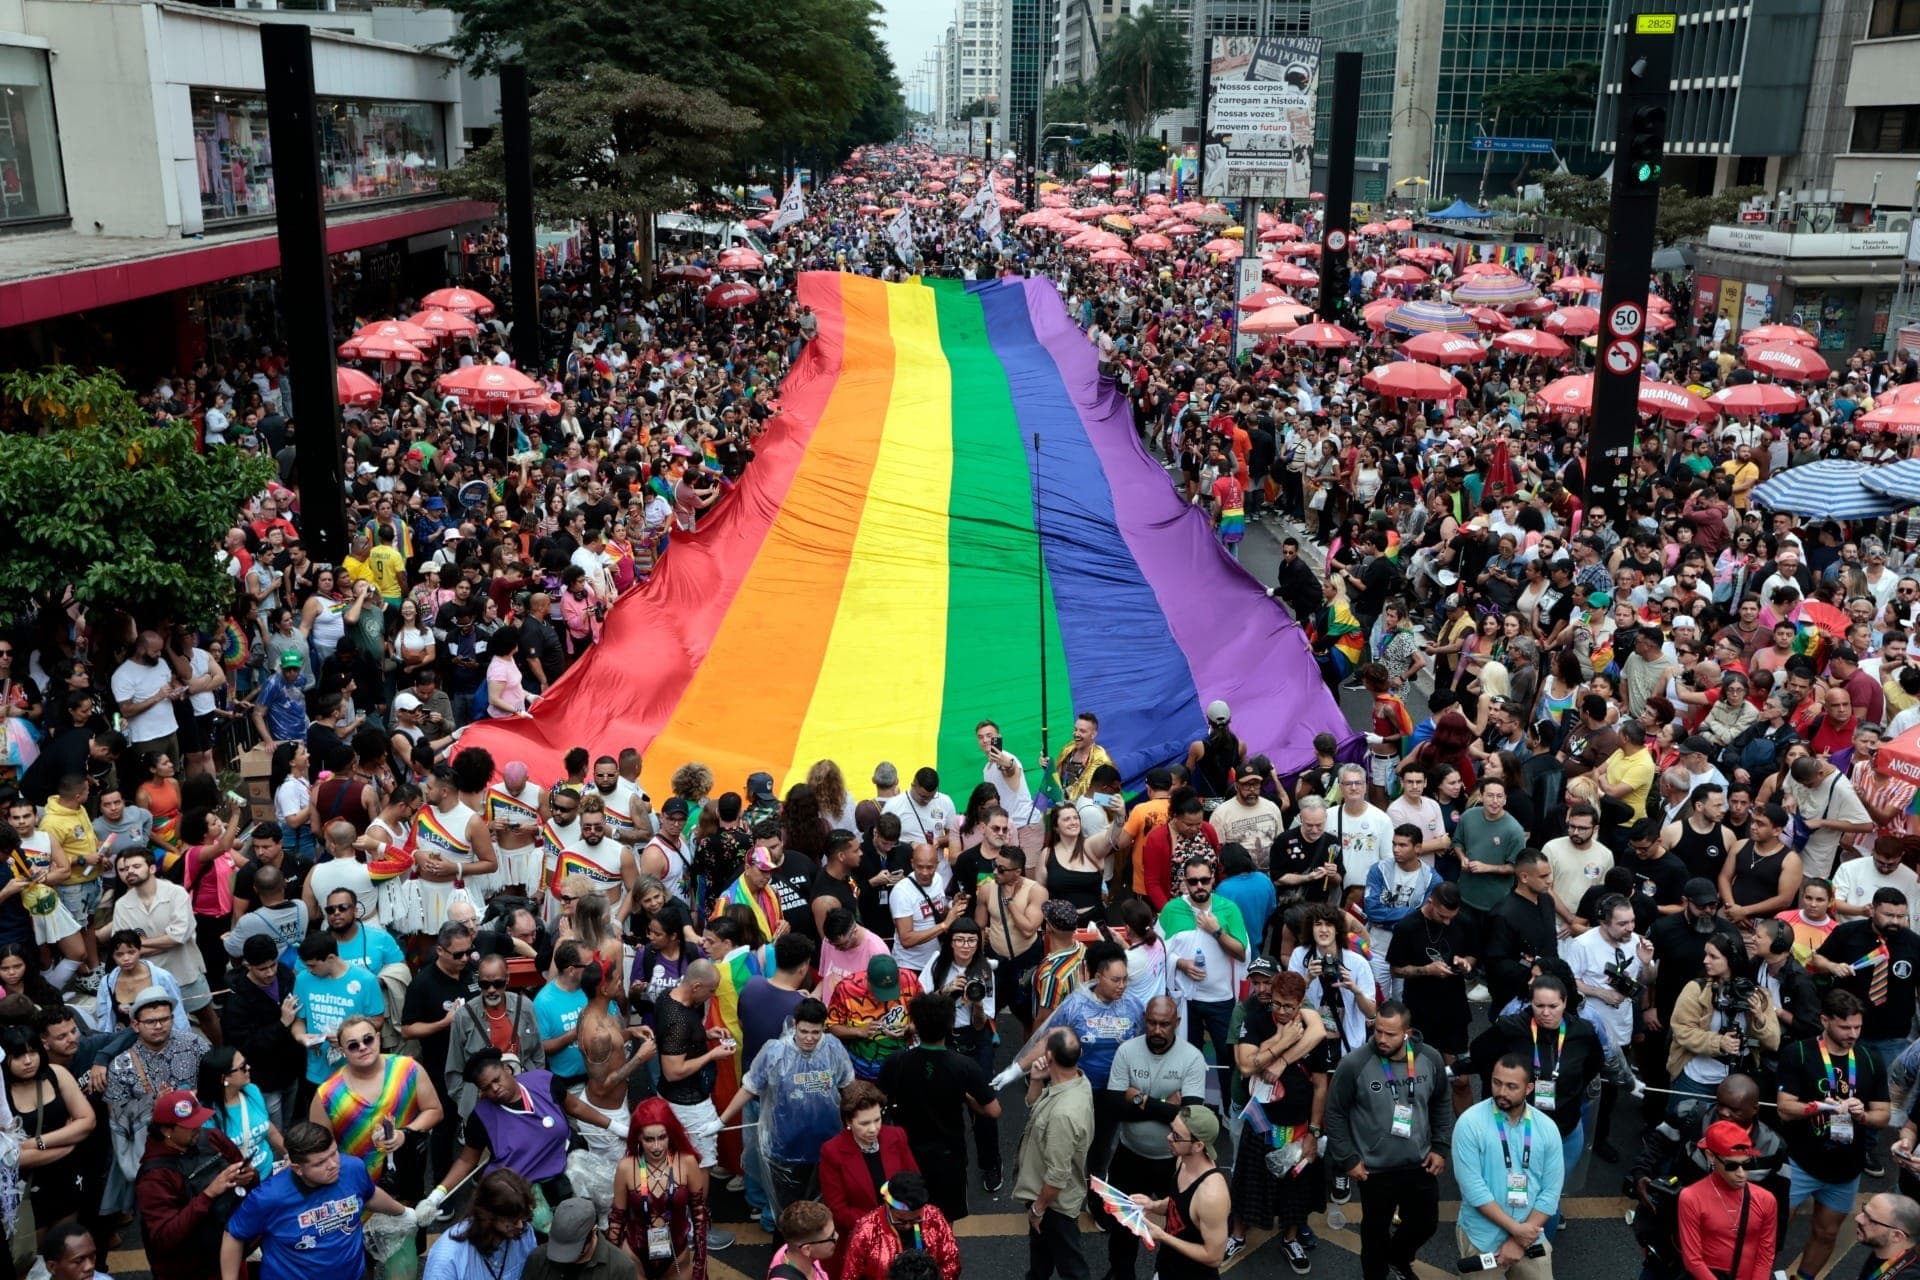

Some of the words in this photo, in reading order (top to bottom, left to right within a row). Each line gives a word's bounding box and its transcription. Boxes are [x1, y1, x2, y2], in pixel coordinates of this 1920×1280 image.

[1648, 19, 1671, 28] 2825
[1260, 45, 1276, 59] do
[1219, 83, 1252, 92] Nossos
[1253, 84, 1284, 94] corpos
[1218, 97, 1261, 107] carregam
[1263, 98, 1269, 106] a
[1270, 95, 1307, 106] história,
[1217, 110, 1248, 118] nossas
[1250, 111, 1276, 119] vozes
[1216, 123, 1250, 132] movem
[1252, 124, 1258, 132] o
[1260, 122, 1287, 132] futuro
[1615, 310, 1637, 326] 50
[1759, 351, 1801, 368] BRAHMA
[486, 390, 509, 398] AMSTEL
[1640, 388, 1689, 408] BRAHMA
[1897, 424, 1920, 432] AMSTE
[376, 561, 384, 581] 9
[1888, 758, 1920, 779] AMSTE
[309, 993, 355, 1008] POLÍTICAS
[1133, 1069, 1150, 1079] 169
